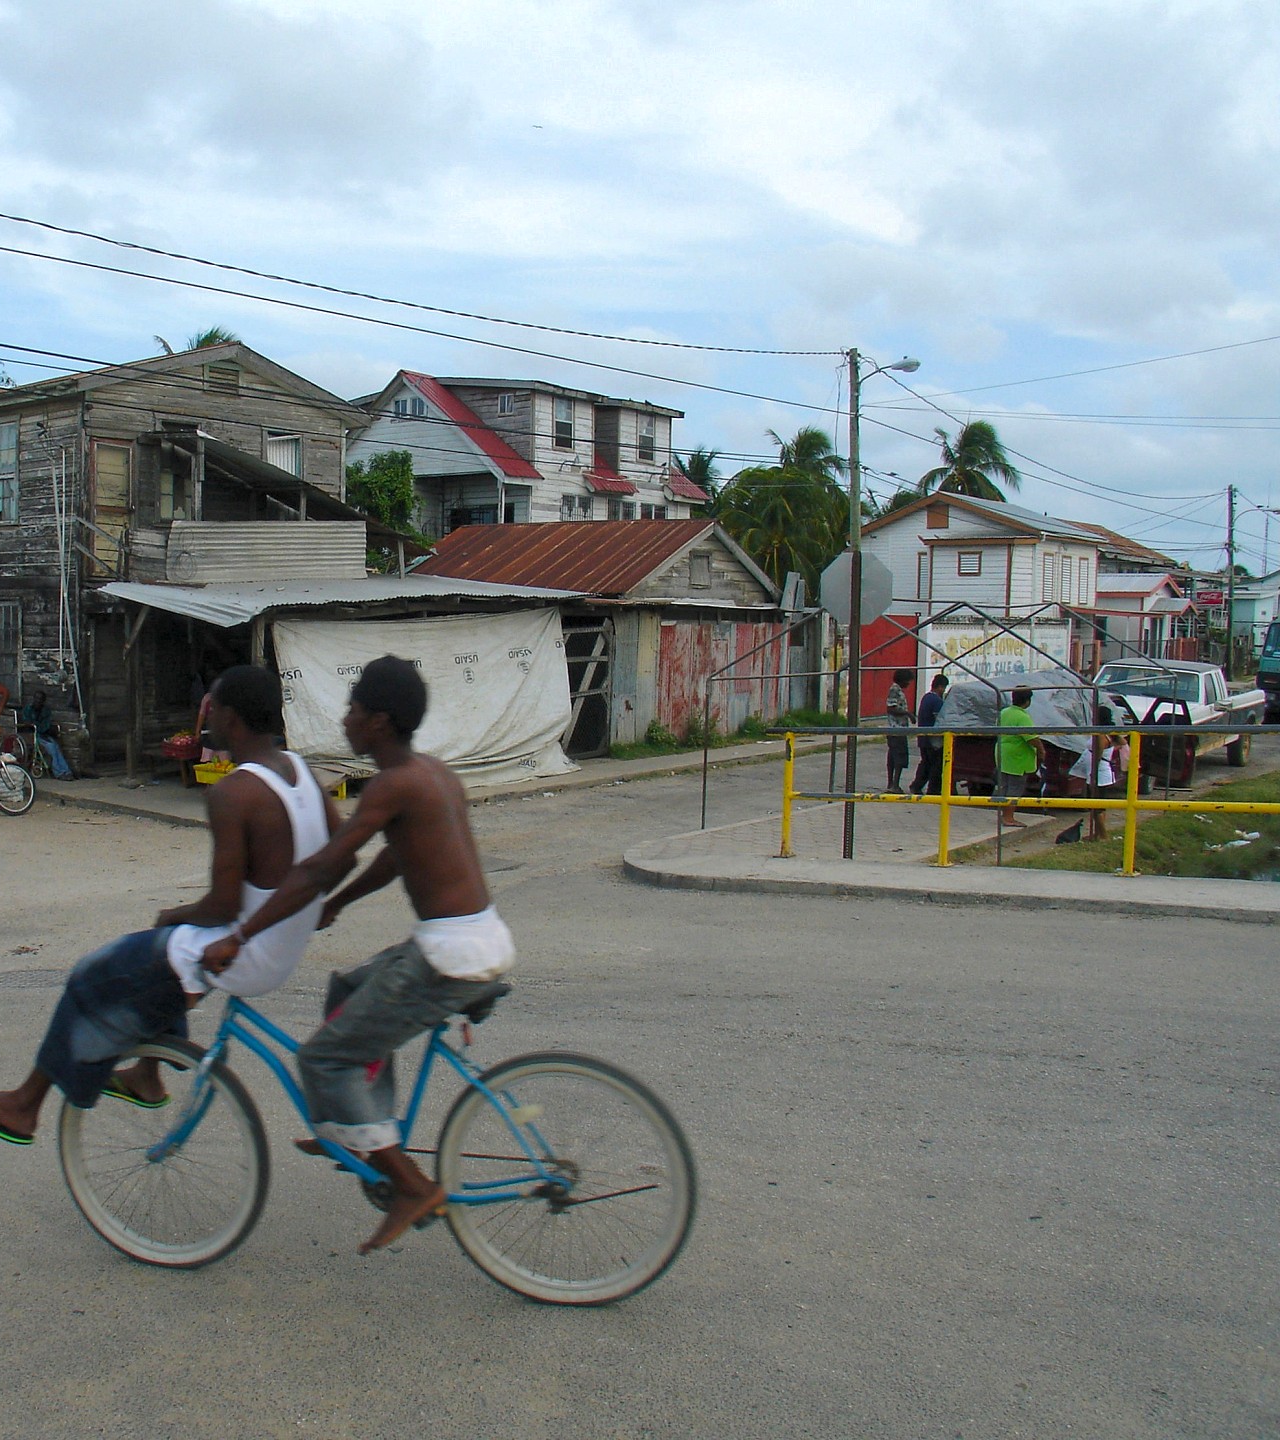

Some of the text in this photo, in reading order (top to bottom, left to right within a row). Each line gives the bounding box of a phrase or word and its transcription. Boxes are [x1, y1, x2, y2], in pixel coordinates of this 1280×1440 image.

[508, 648, 532, 658] USAID
[454, 654, 479, 664] USAID
[337, 665, 363, 676] USAID
